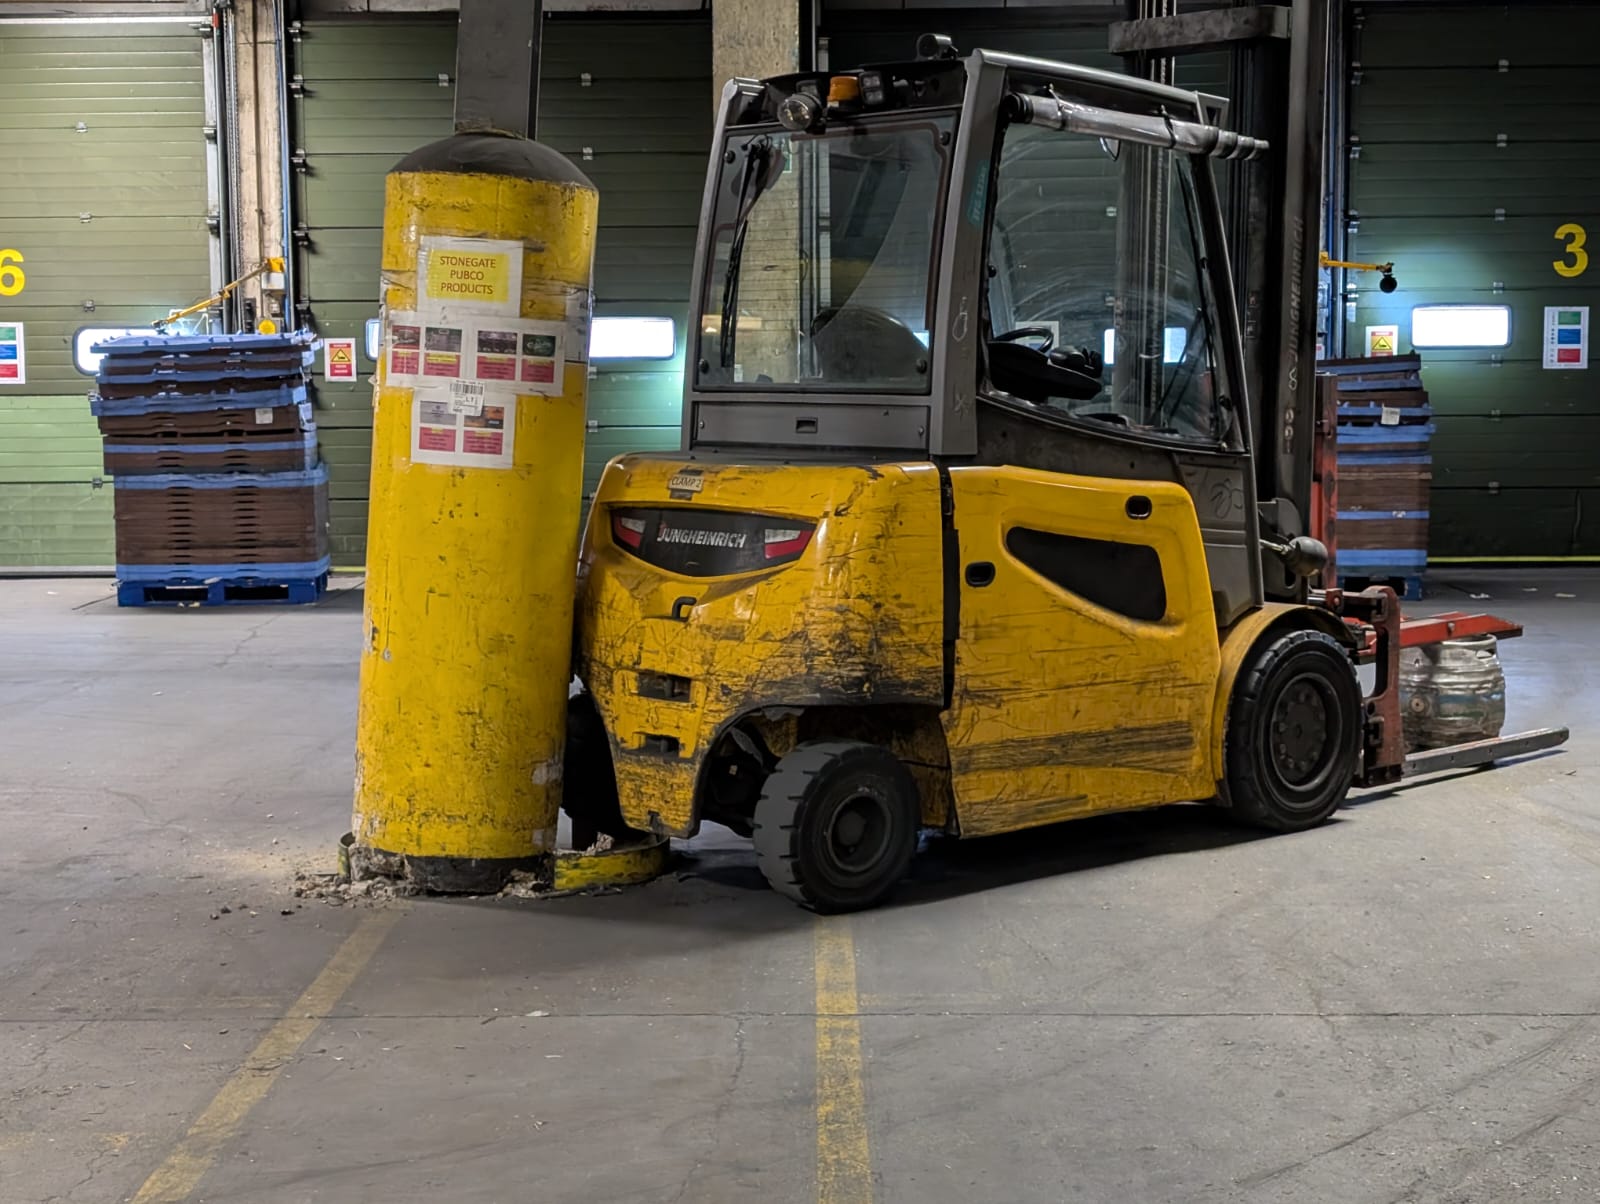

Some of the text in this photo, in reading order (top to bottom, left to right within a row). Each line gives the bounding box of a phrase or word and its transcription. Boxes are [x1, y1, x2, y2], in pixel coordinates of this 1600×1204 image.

[1552, 223, 1589, 278] 3
[0, 248, 25, 296] 6
[440, 257, 496, 268] STONEGATE
[450, 270, 484, 281] PUBCO
[441, 283, 493, 294] PRODUCTS
[1288, 218, 1305, 363] JUNGHEINRICH
[657, 529, 746, 549] JUNGHEINRICH
